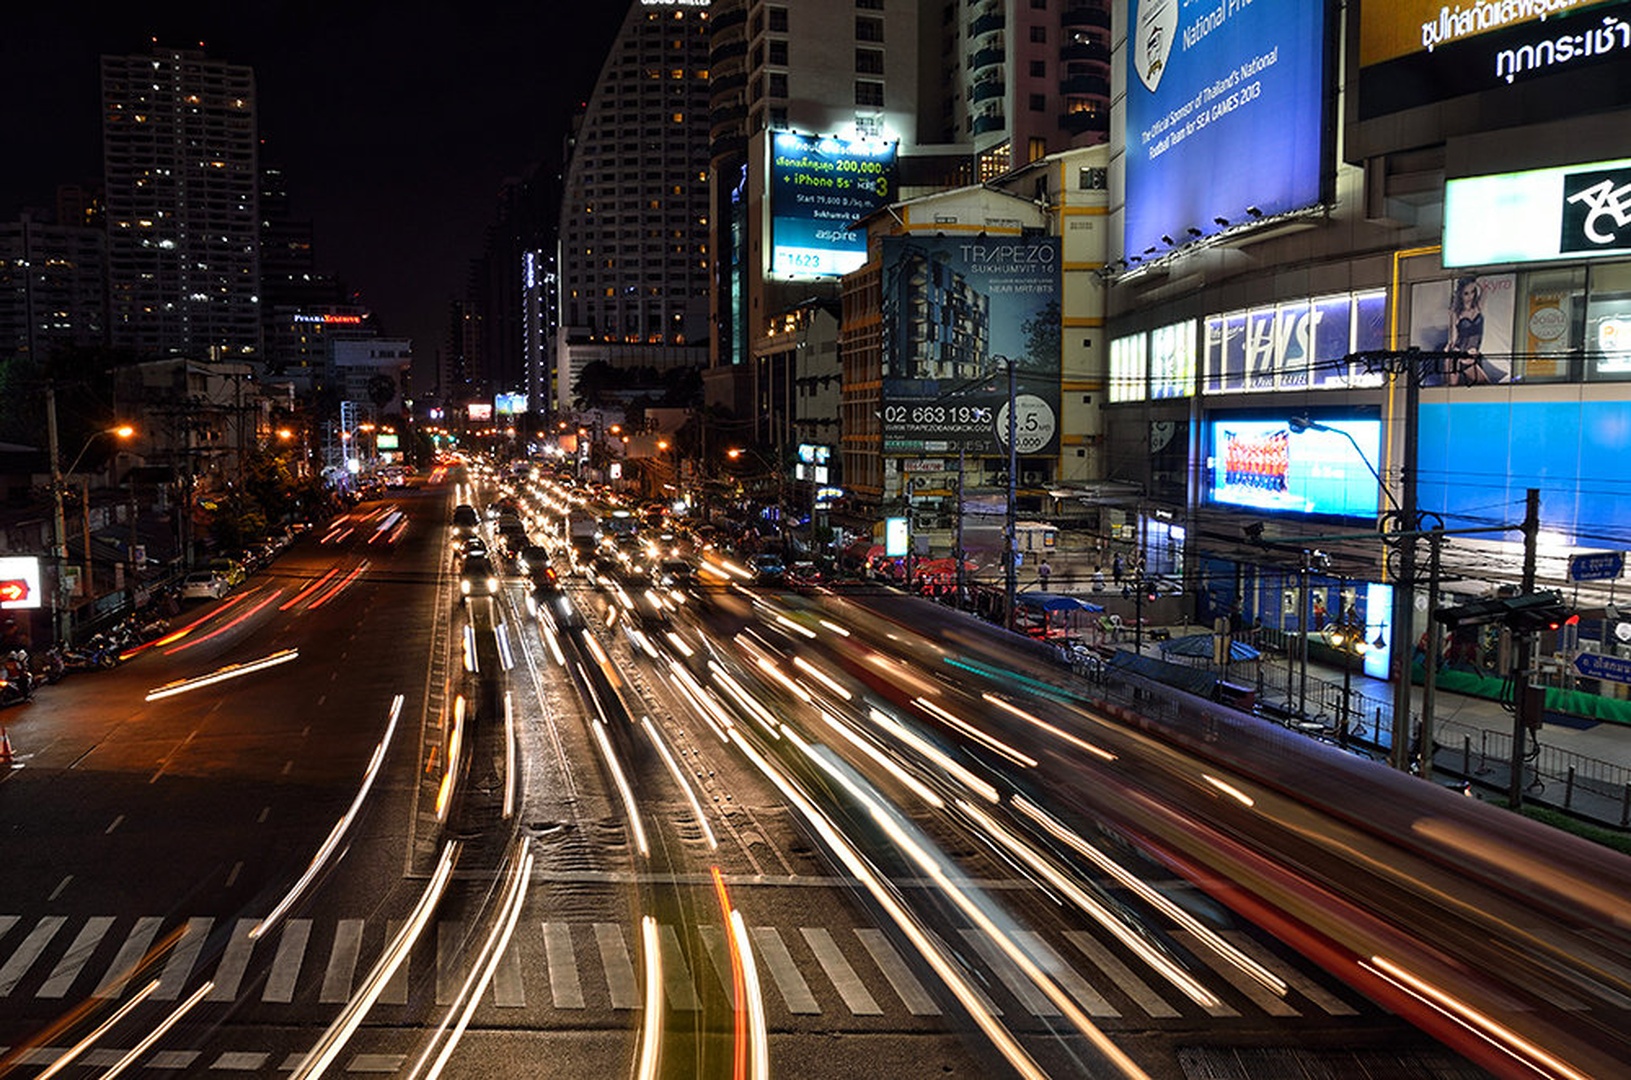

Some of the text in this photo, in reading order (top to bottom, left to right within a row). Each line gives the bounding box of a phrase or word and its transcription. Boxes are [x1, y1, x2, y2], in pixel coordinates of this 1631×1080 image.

[1182, 0, 1226, 52] National
[1151, 117, 1170, 138] Official
[1170, 100, 1194, 126] Sponsor
[1203, 69, 1240, 104] Thailand's
[1241, 45, 1278, 80] National
[1149, 135, 1170, 161] Football
[1170, 124, 1186, 146] Team
[1196, 110, 1211, 131] SEA
[1211, 92, 1239, 122] GAMES
[1240, 80, 1262, 105] 2013
[794, 173, 833, 188] iPhone
[876, 177, 888, 197] 3
[815, 229, 857, 242] aspire
[788, 253, 820, 268] 1623
[960, 244, 1055, 263] TRAPEZO
[971, 264, 1055, 273] SUKHUMVIT 16
[989, 285, 1012, 293] NEAR
[884, 405, 907, 423] 02
[912, 405, 946, 424] 663
